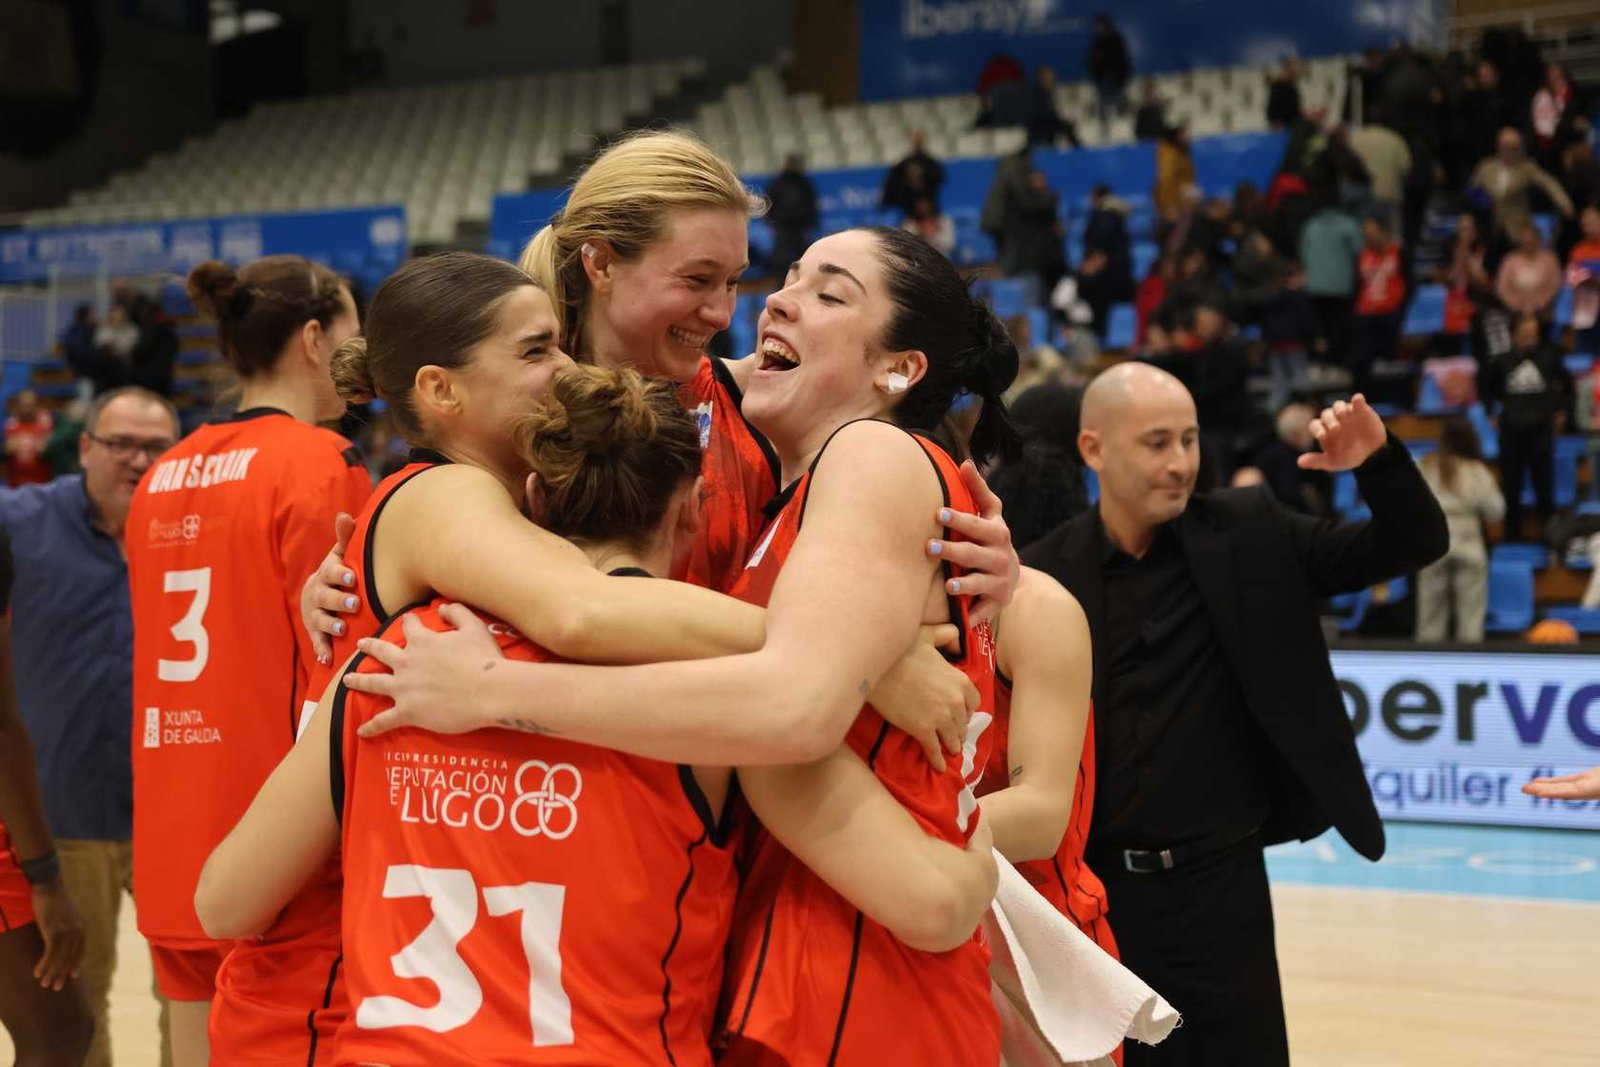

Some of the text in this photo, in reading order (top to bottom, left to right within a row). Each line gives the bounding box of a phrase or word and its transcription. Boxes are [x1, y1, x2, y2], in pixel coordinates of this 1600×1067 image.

[157, 567, 211, 682] 3
[164, 709, 203, 727] XUNTA
[164, 728, 182, 744] DE
[385, 765, 508, 796] EPUTACIÓN
[400, 786, 505, 832] LUGO
[356, 864, 575, 1047] 31
